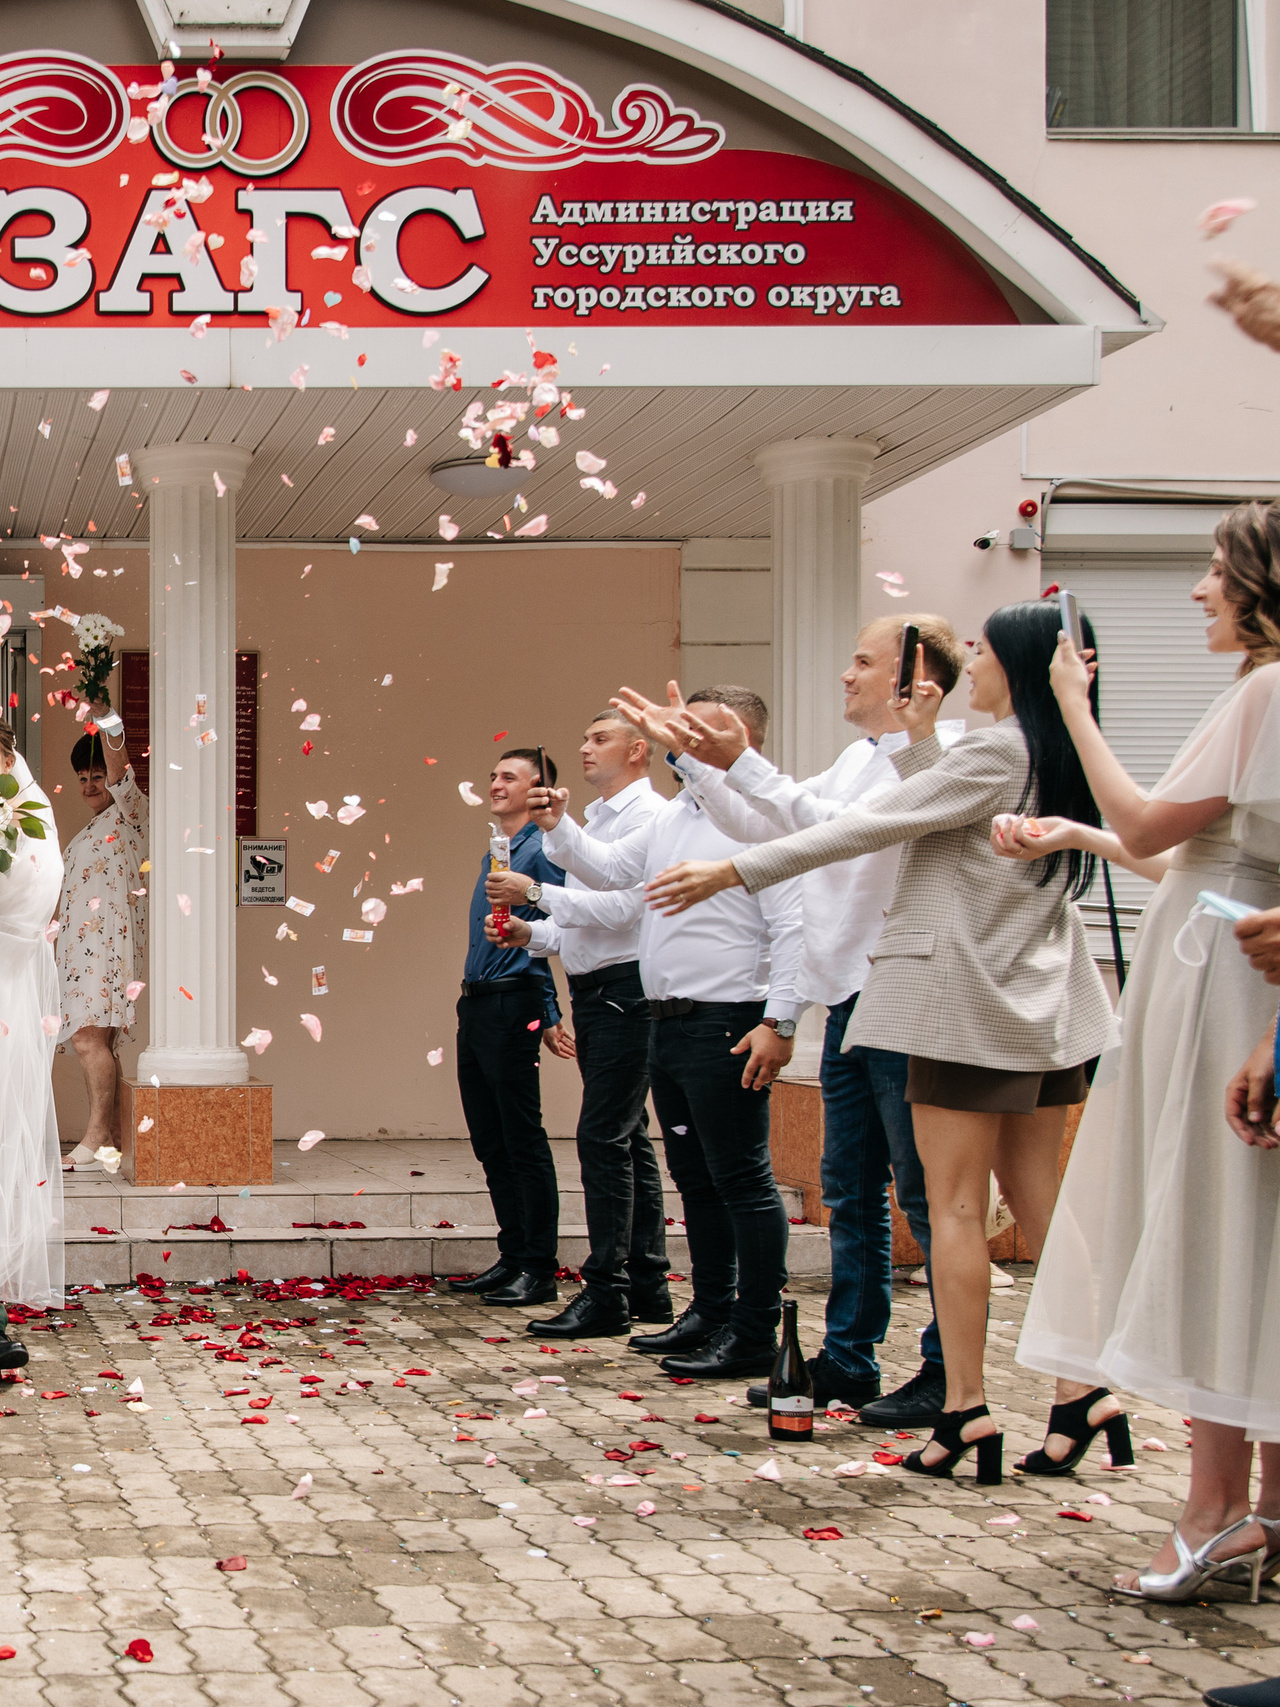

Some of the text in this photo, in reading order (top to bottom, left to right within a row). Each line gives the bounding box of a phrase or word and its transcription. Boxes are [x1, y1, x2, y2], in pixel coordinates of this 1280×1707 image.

[531, 195, 854, 230] Администрация
[531, 235, 806, 273] Уссурийского
[533, 285, 901, 315] городского округа
[242, 844, 286, 852] ВНИМАНИЕ!
[251, 886, 276, 894] ВЕДЕТСЯ
